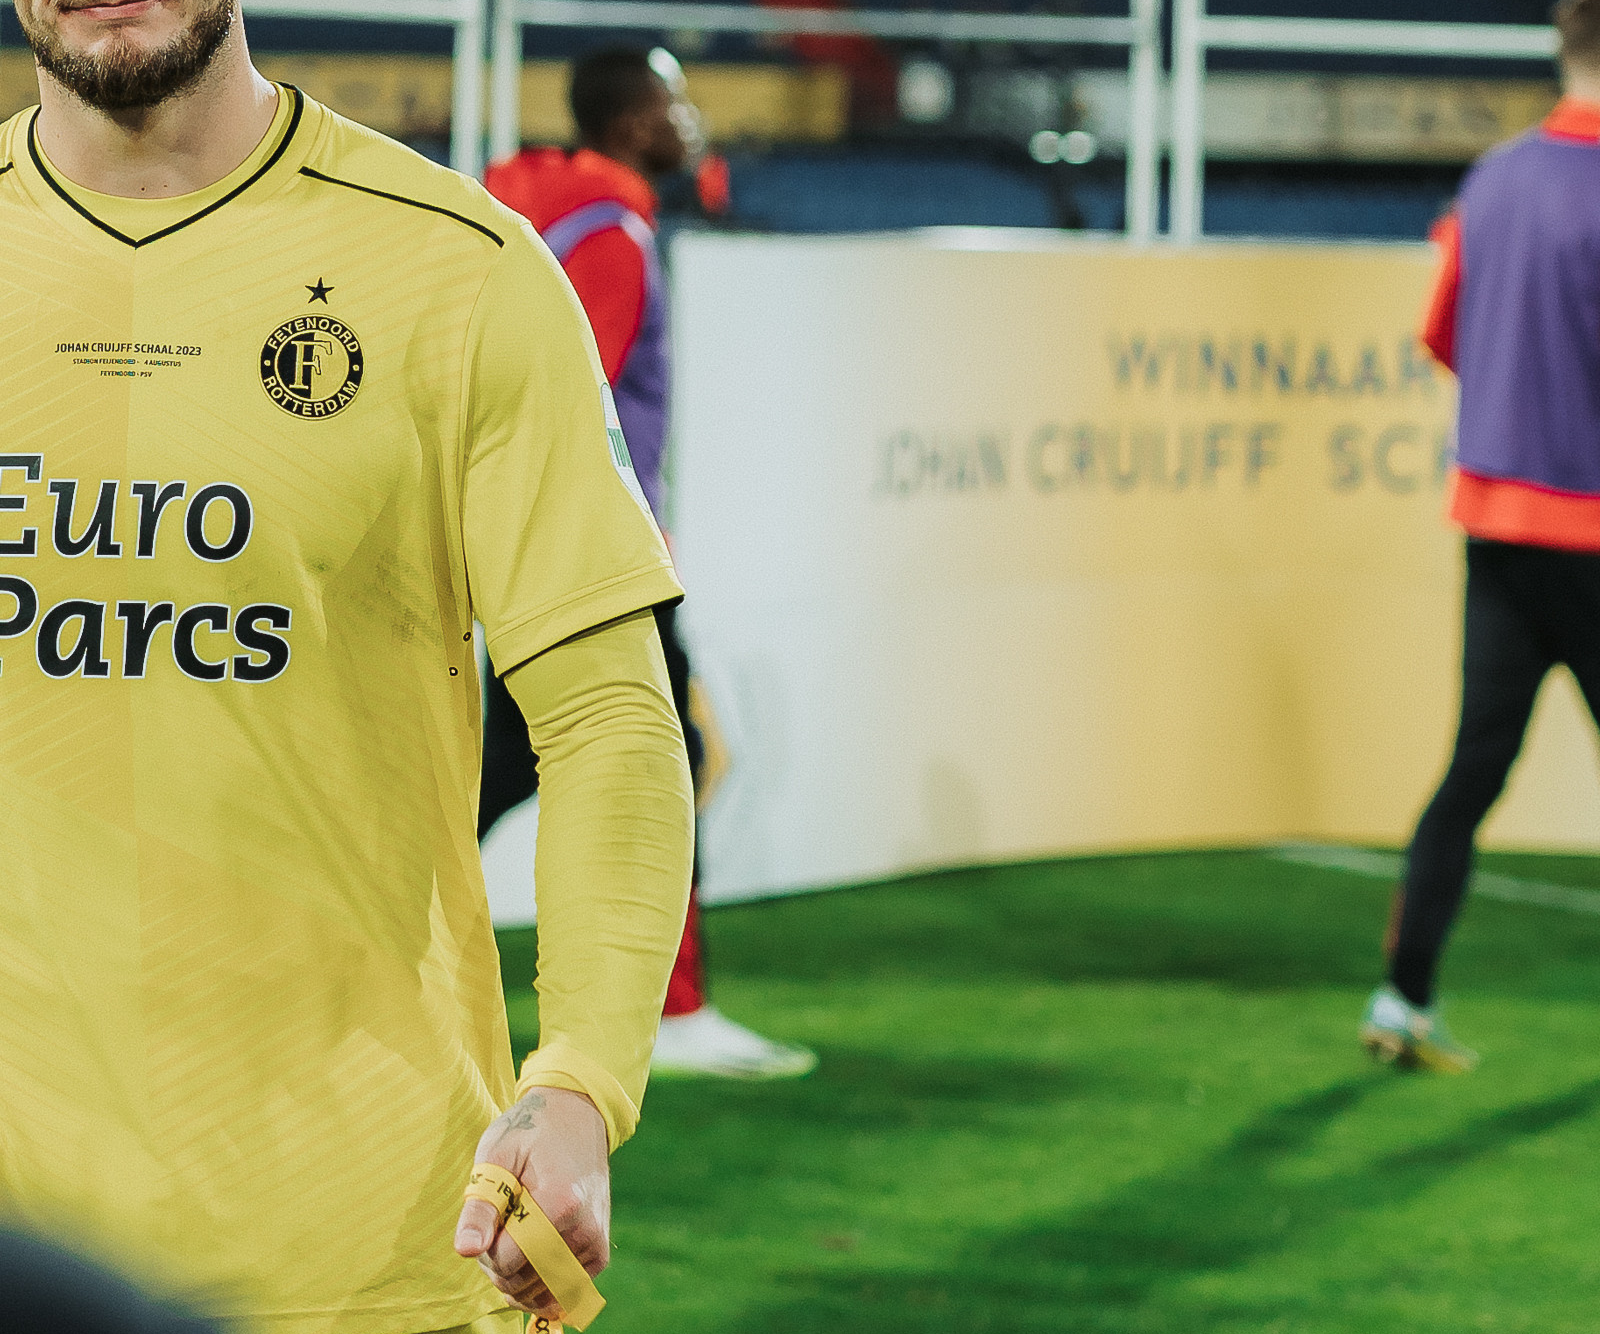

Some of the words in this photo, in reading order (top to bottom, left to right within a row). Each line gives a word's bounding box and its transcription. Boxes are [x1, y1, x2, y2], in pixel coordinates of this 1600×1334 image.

[55, 343, 89, 353] JOHAN
[91, 343, 132, 353] CRUIJFF
[134, 343, 173, 354] SCHAAL
[175, 346, 201, 356] 2023
[267, 317, 359, 353] FEYENOORD
[1109, 331, 1442, 398] WINNAAR
[264, 375, 359, 416] ROTTERDAM
[1026, 421, 1283, 495] CRUIJFF
